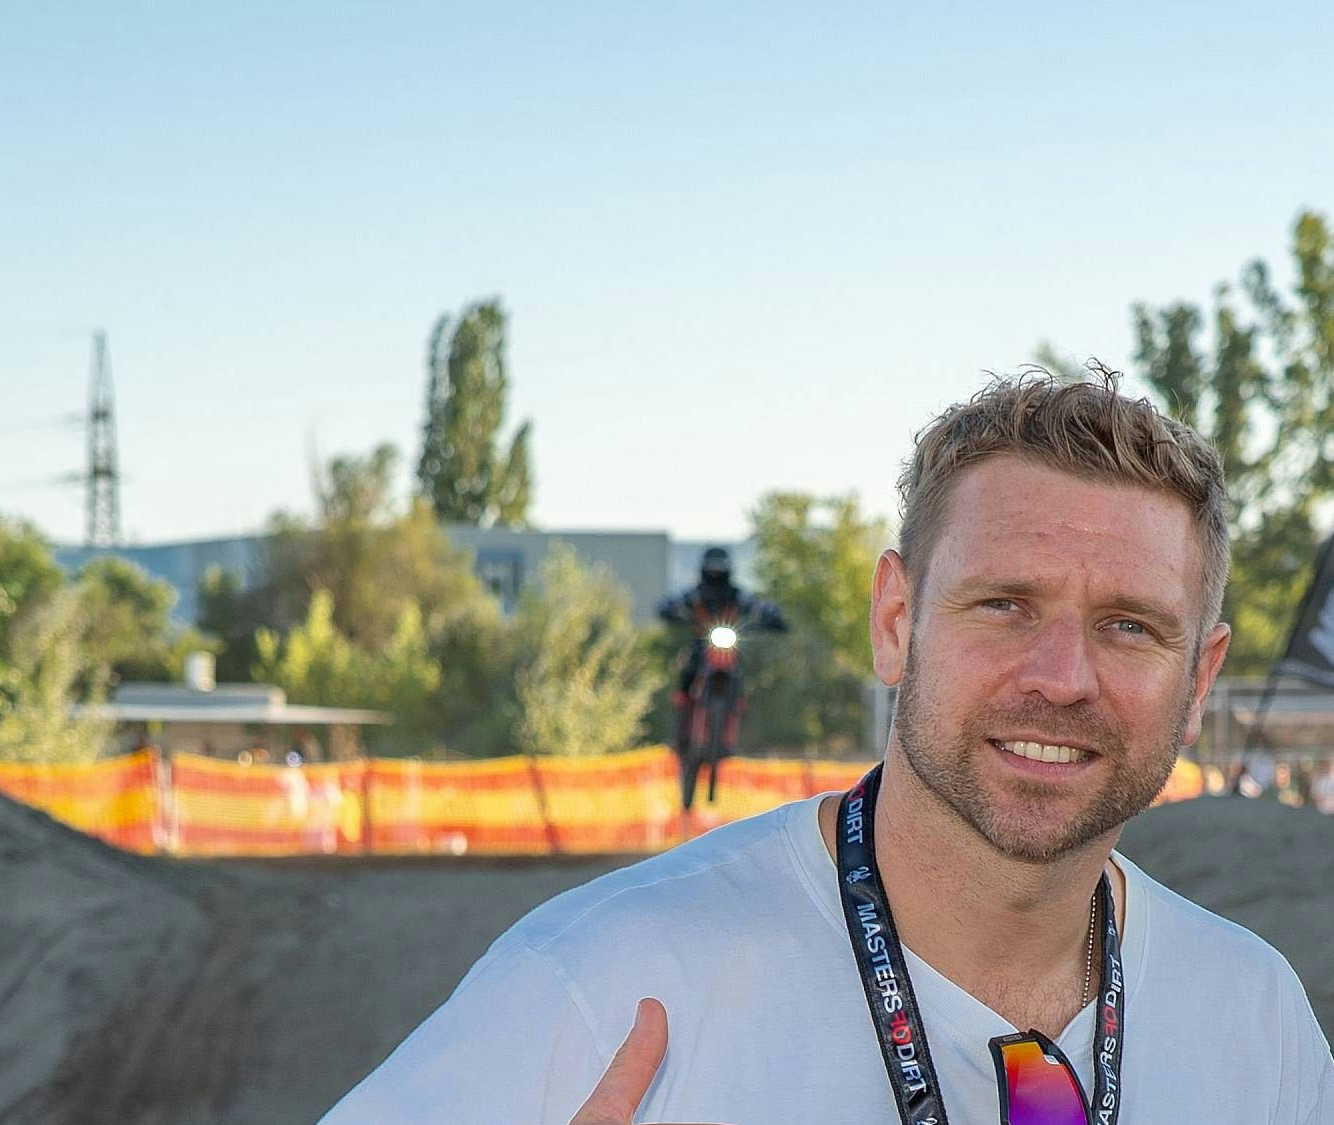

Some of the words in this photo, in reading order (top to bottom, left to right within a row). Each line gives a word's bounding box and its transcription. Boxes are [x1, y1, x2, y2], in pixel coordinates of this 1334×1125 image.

[847, 798, 863, 843] DIRT
[857, 903, 903, 1013] MASTERS
[895, 1042, 927, 1093] DIRT
[1106, 954, 1121, 1009] DIRT
